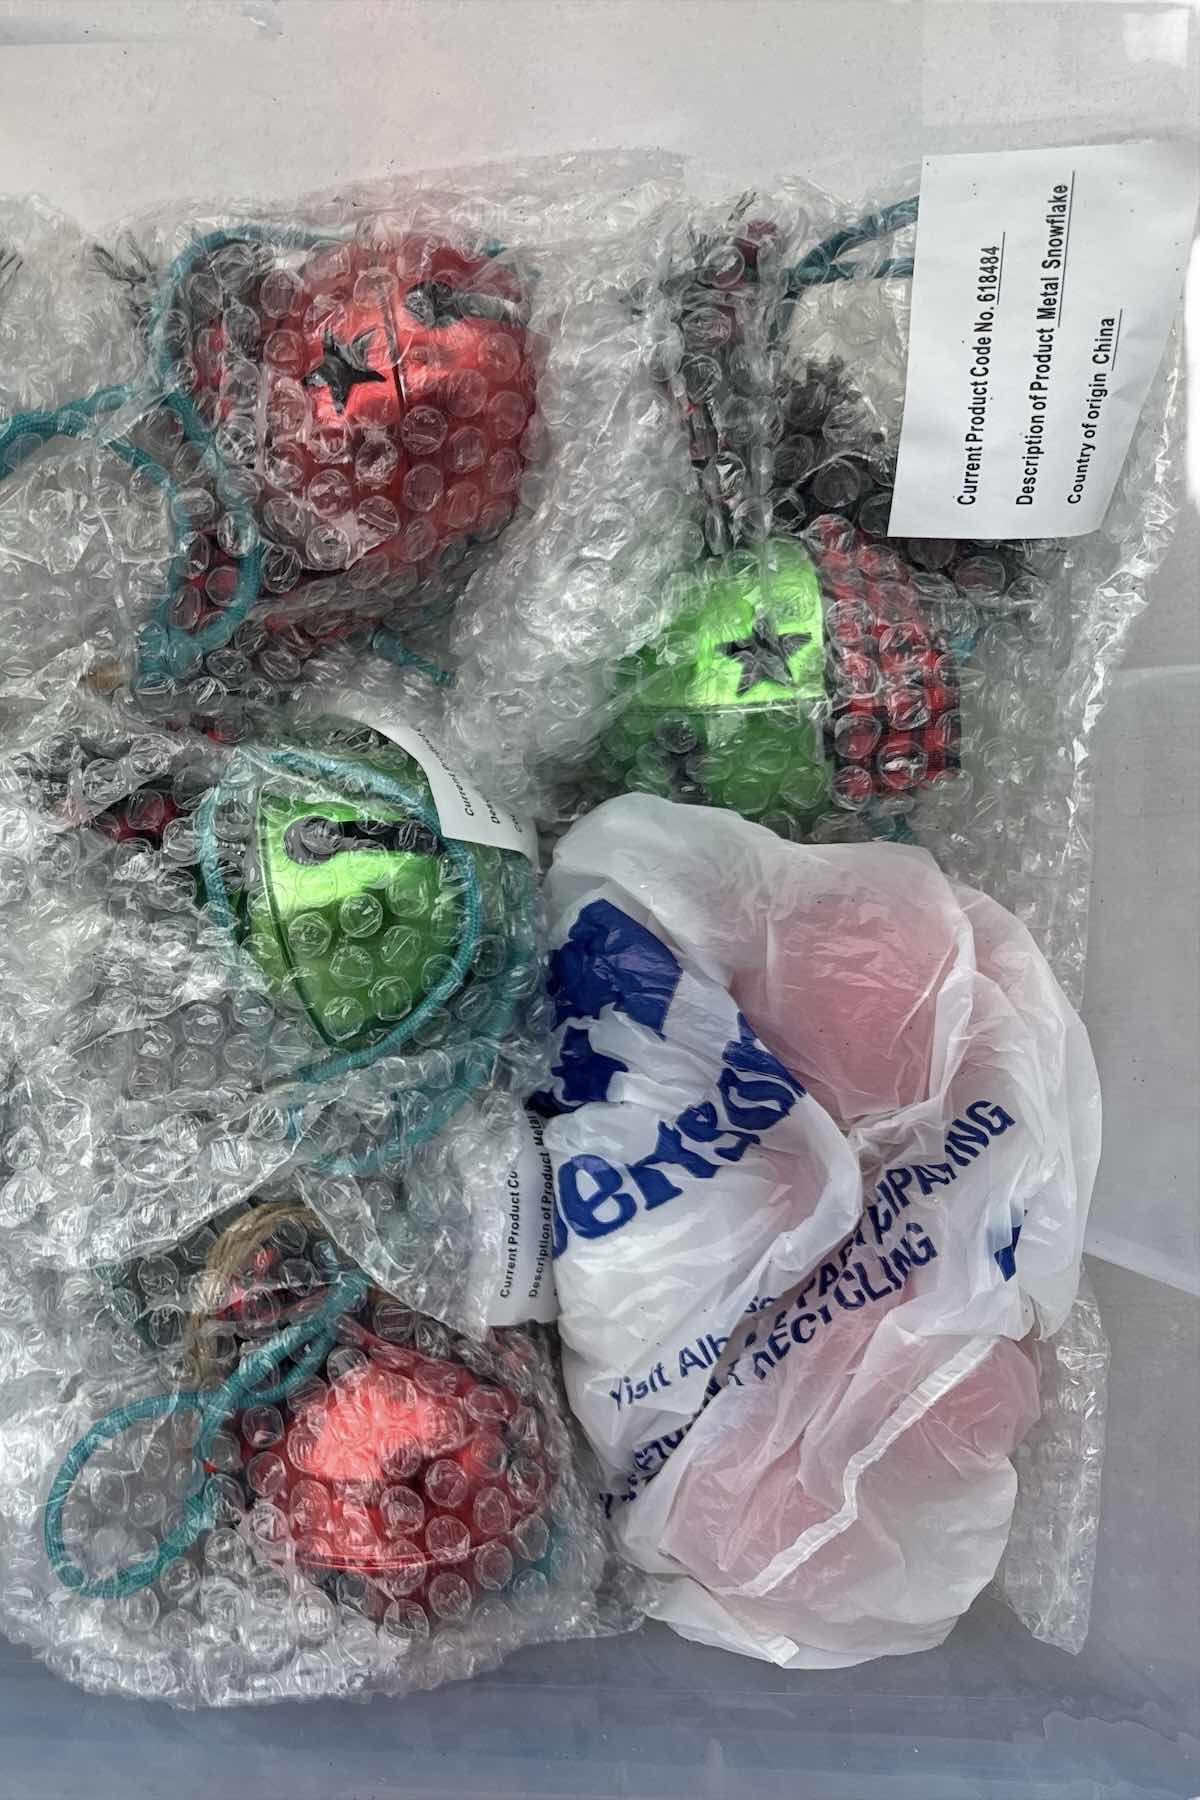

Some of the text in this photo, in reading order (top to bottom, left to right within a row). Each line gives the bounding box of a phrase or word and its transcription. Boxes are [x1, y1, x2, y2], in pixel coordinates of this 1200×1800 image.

[1016, 185, 1068, 505] Description of Product Metal Snowflake
[957, 246, 999, 505] Current Product Code No. 618484
[1068, 318, 1114, 504] Country of origin China
[539, 1152, 553, 1204] Product
[508, 1192, 519, 1245] Product
[540, 1206, 551, 1220] of
[500, 1248, 517, 1298] Current
[529, 1223, 552, 1298] Description
[608, 1361, 671, 1411] Visit
